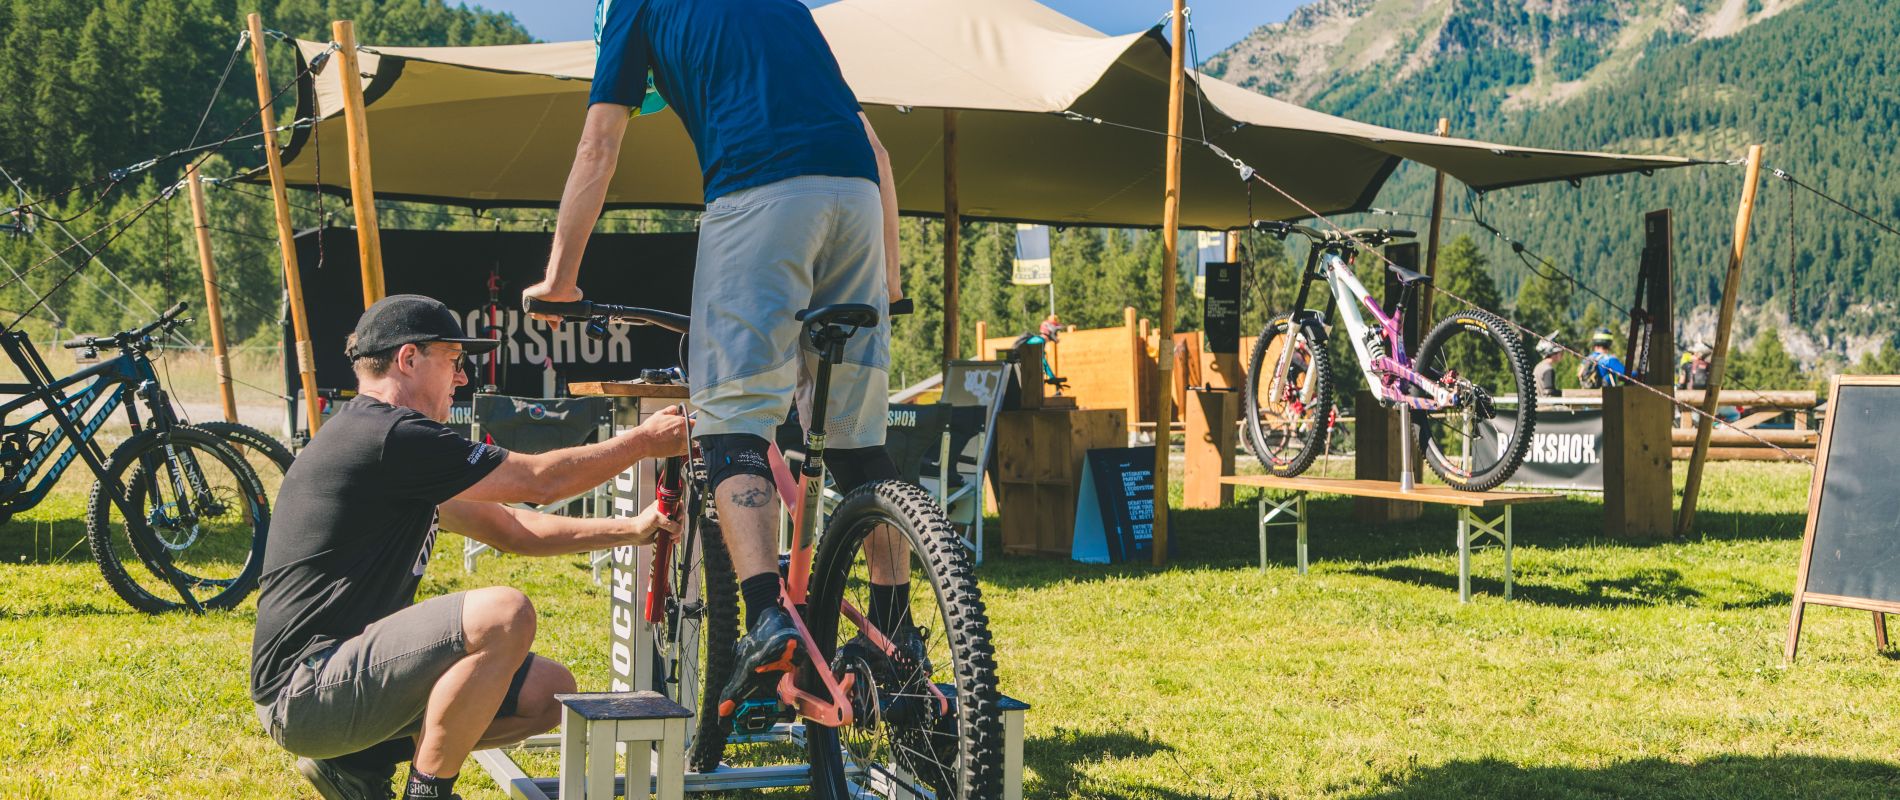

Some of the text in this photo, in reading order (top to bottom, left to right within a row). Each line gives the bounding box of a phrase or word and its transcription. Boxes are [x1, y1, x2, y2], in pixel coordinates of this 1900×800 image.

[448, 309, 632, 365] CKSHOX
[888, 410, 917, 427] SHOX
[230, 432, 272, 452] MAXXIS
[216, 443, 260, 497] SCHWALBE
